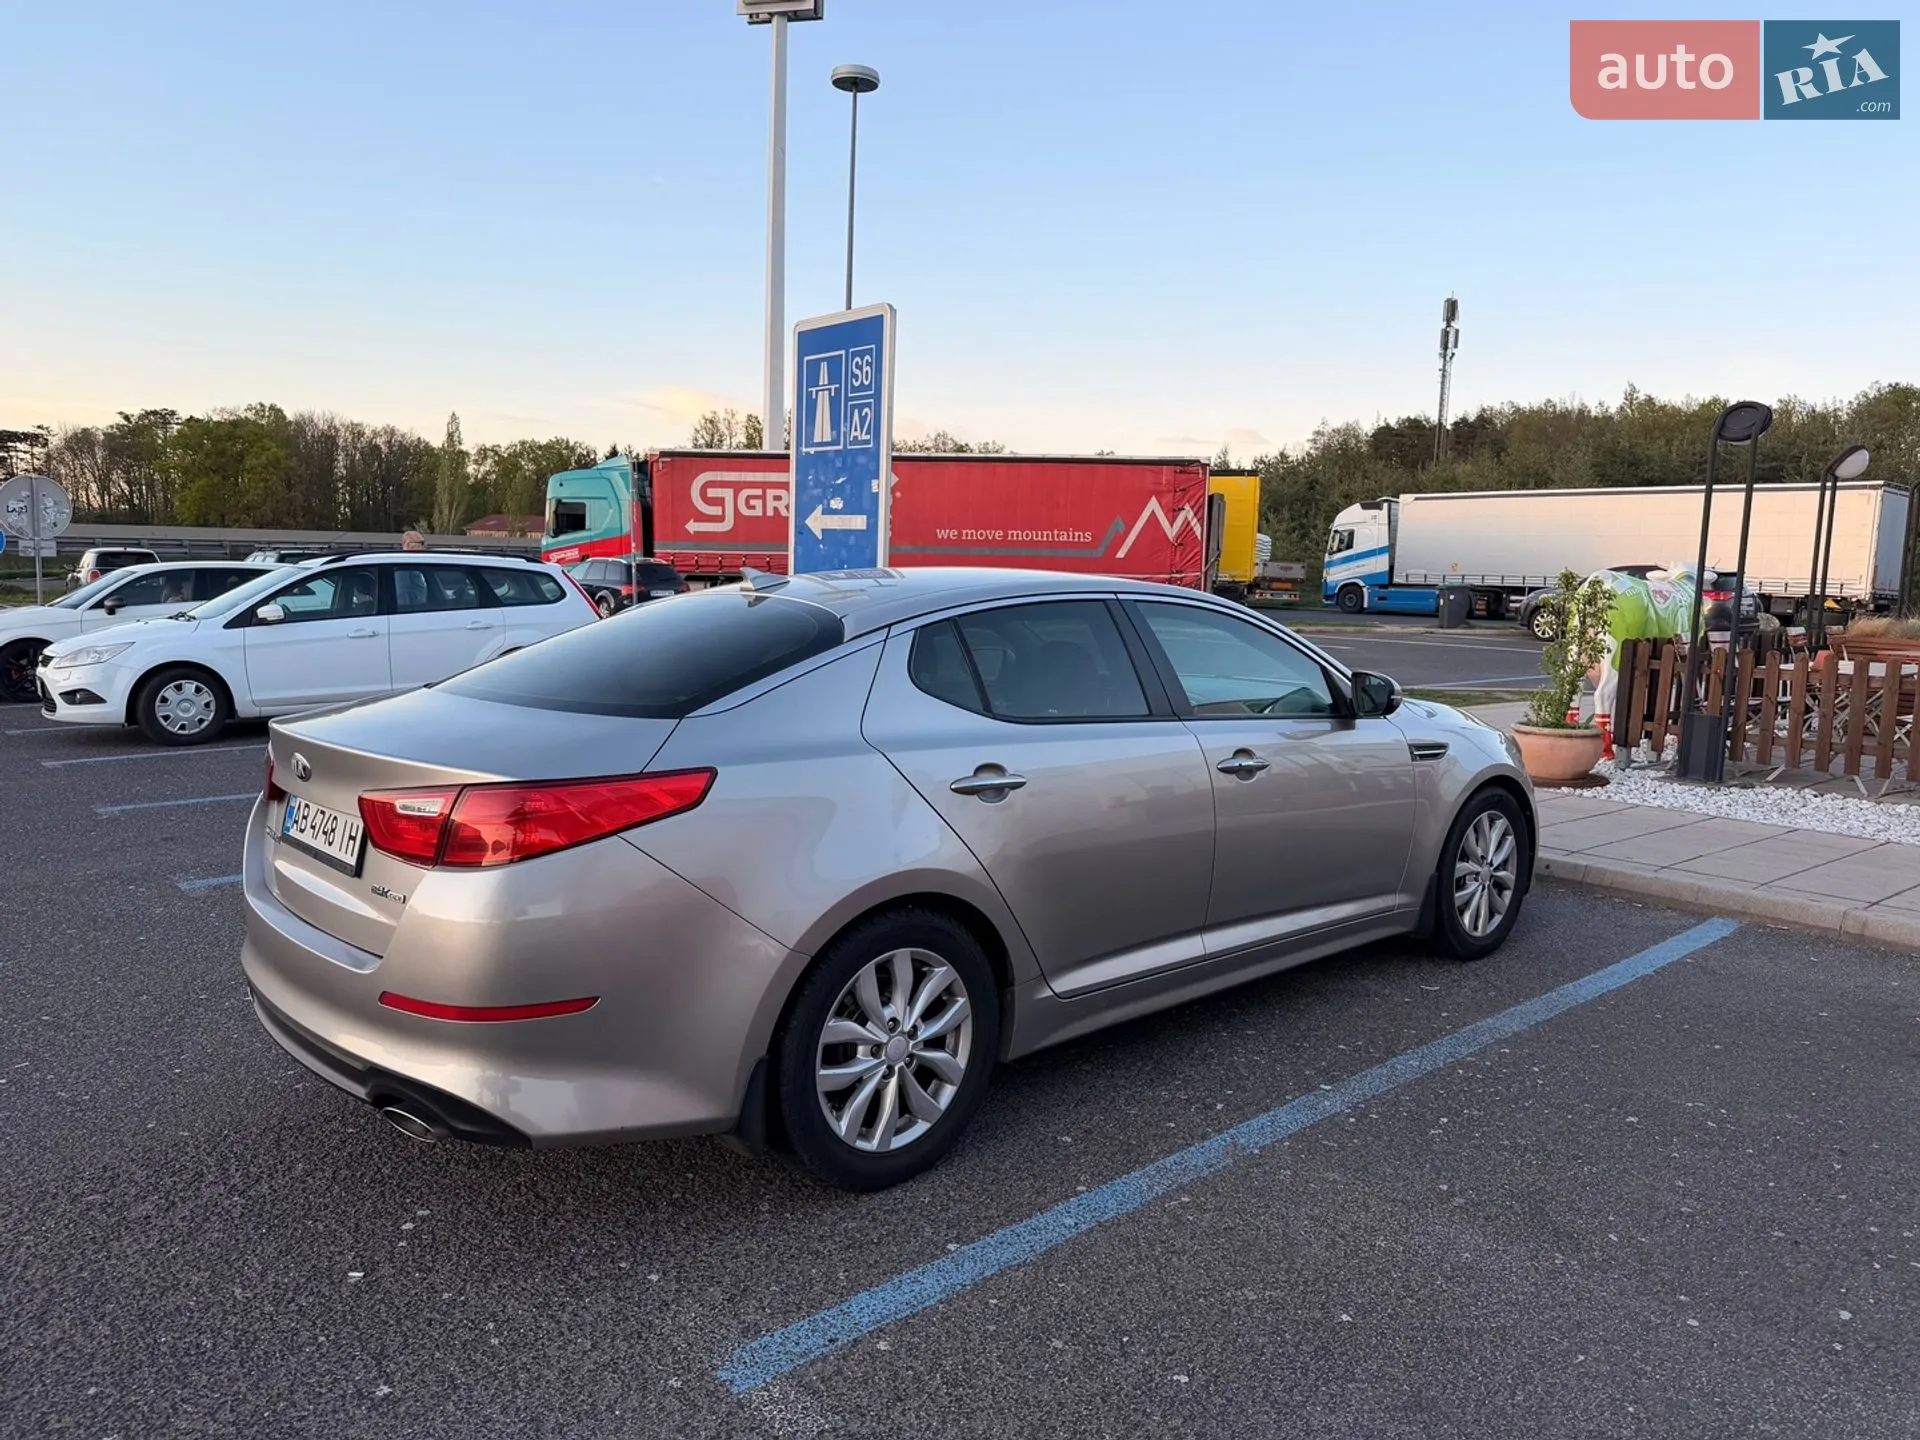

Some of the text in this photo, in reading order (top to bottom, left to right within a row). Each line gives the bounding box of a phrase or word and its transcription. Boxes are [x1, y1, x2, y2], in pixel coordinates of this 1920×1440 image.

[851, 355, 872, 387] S6
[849, 408, 871, 442] A2
[936, 527, 1092, 543] we move mountains
[291, 800, 311, 834] AB
[310, 808, 338, 847] 4748
[338, 819, 359, 857] IH
